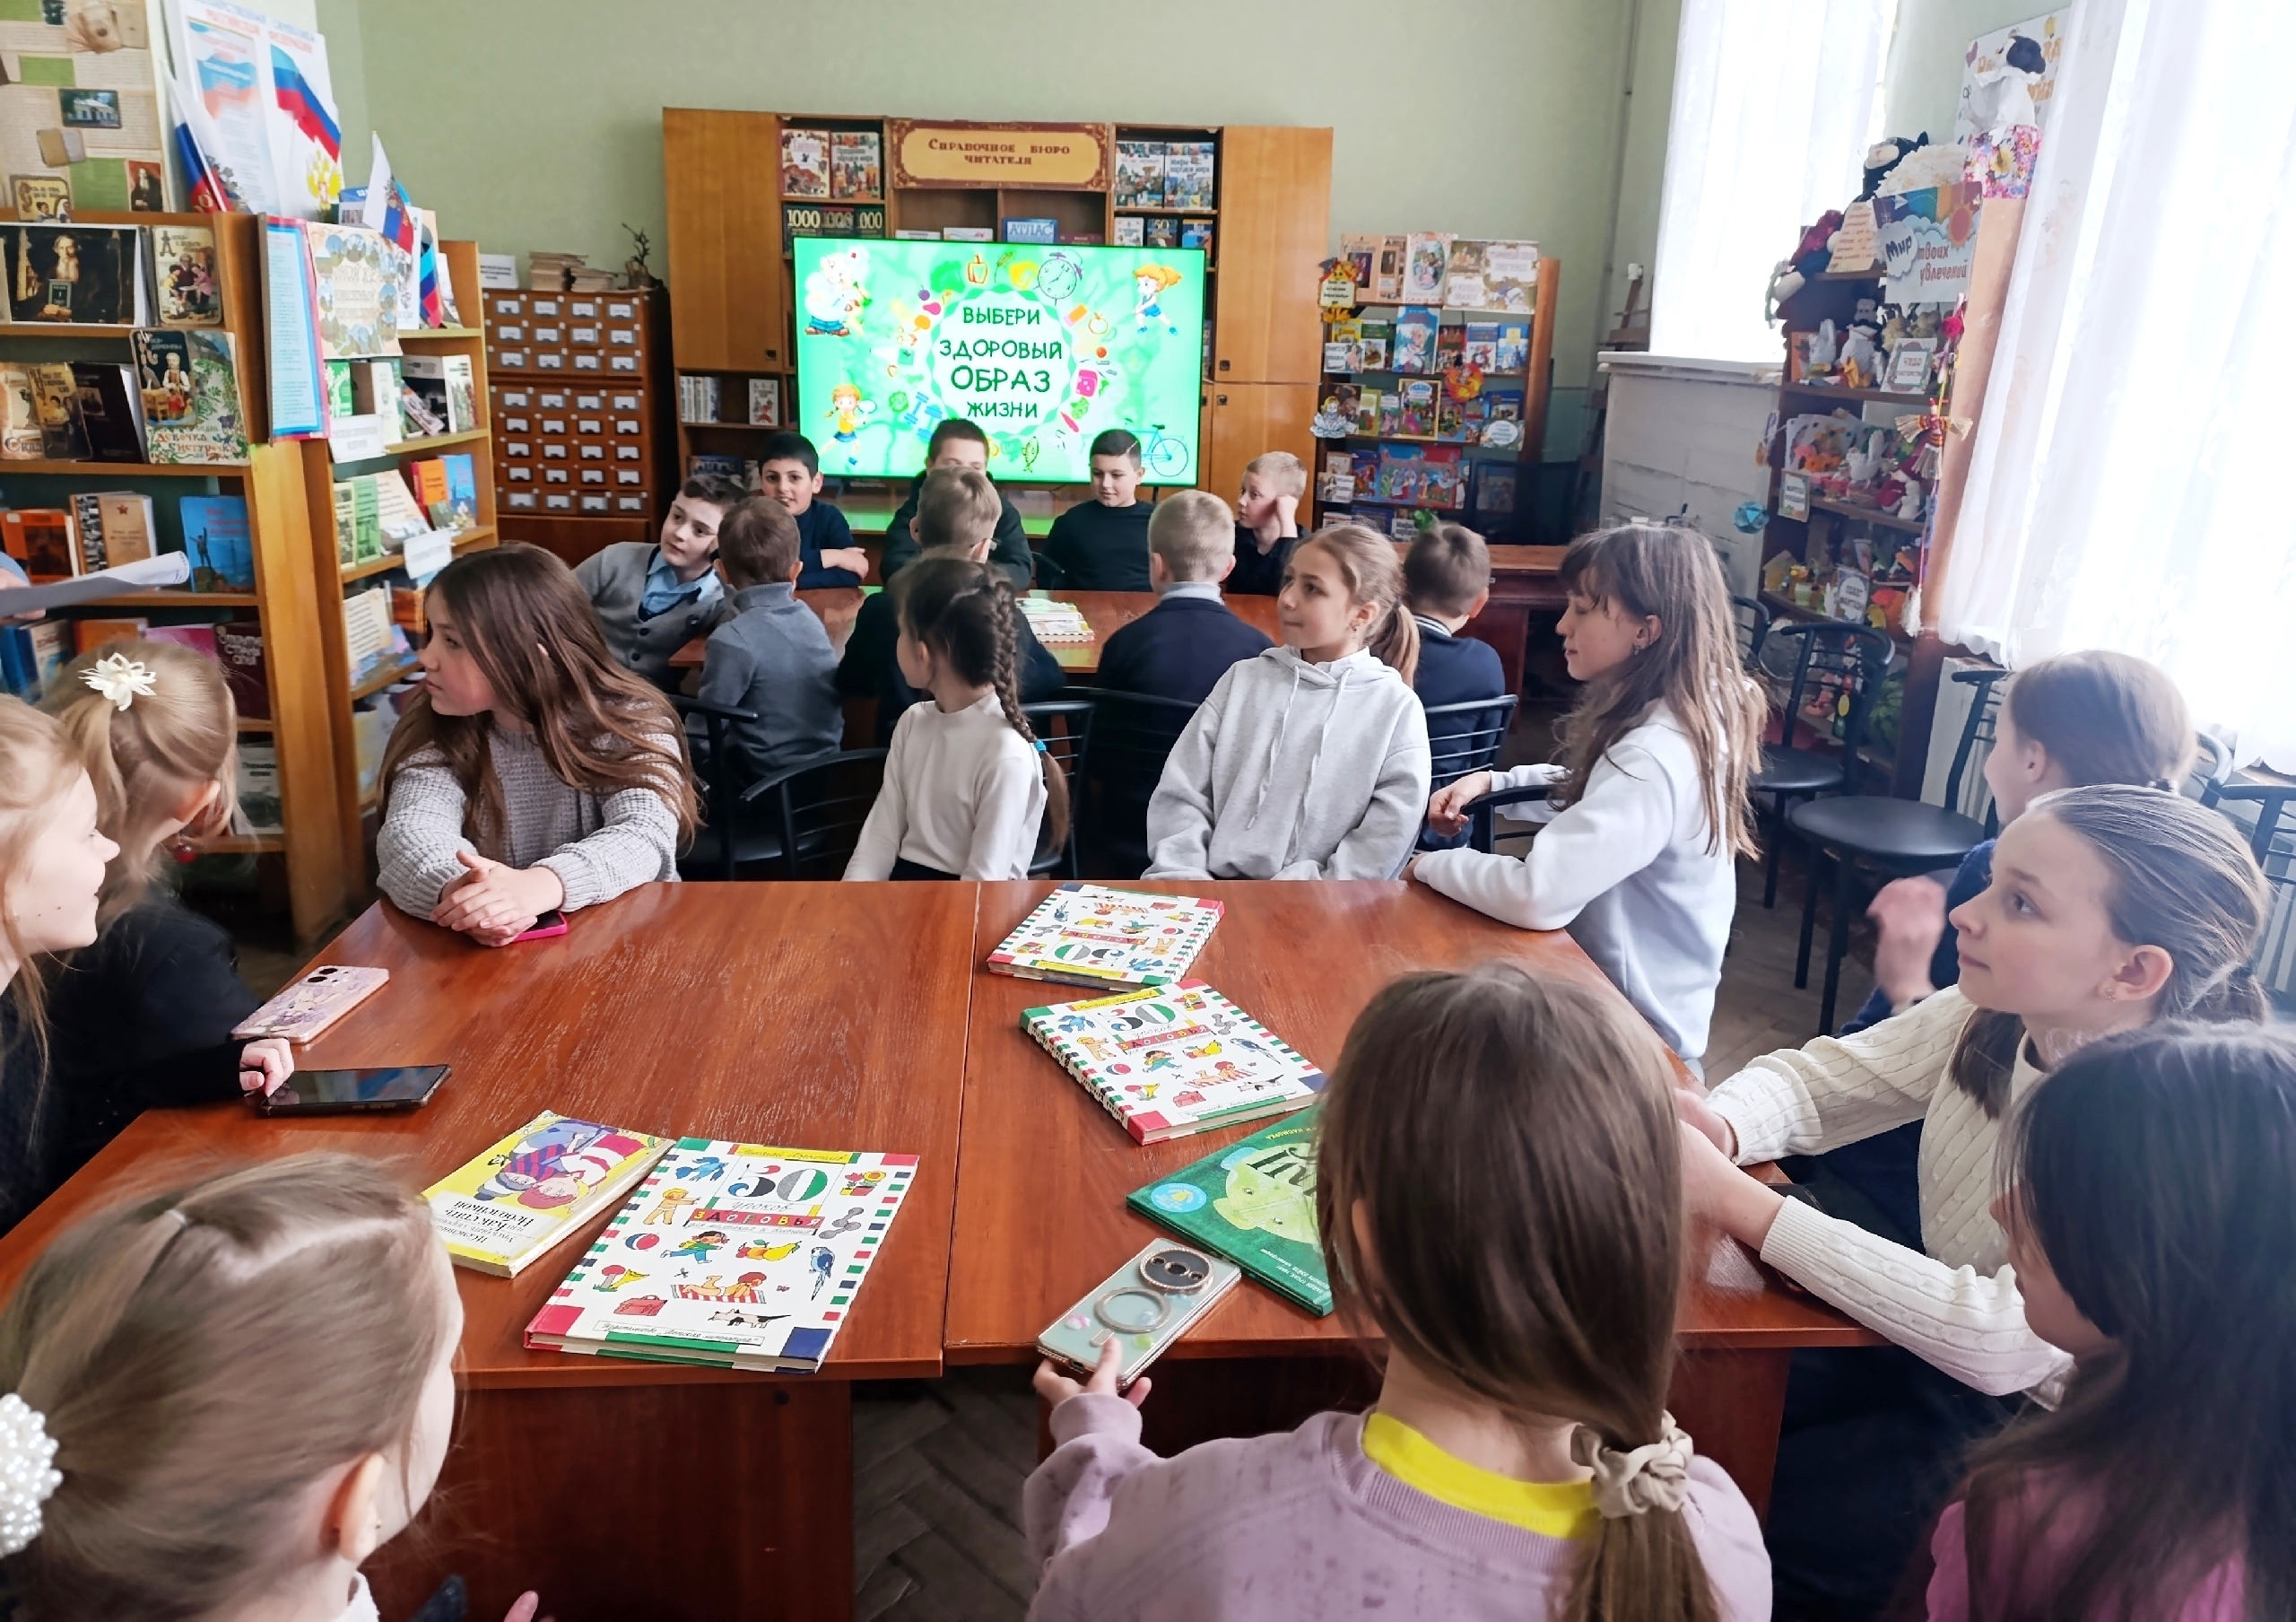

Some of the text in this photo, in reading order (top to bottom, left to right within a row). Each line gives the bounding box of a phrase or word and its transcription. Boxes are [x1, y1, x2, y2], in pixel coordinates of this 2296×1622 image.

[787, 209, 821, 228] 1000
[1009, 224, 1053, 236] АТЛАС
[1885, 235, 1912, 262] Мир
[1918, 241, 1950, 259] твоих
[1919, 258, 1968, 287] увлечений
[962, 306, 1040, 326] ВЫБЕРИ
[939, 338, 1063, 361] ЗДОРОВЫЙ
[950, 364, 1050, 393] ОБРАЗ
[966, 401, 1038, 418] ЖИЗНИ
[1055, 944, 1125, 966] 50
[1098, 1003, 1177, 1031] 50
[727, 1164, 828, 1202] 50
[731, 1201, 794, 1213] уроков
[693, 1210, 822, 1227] ЗДОРОВЬЯ
